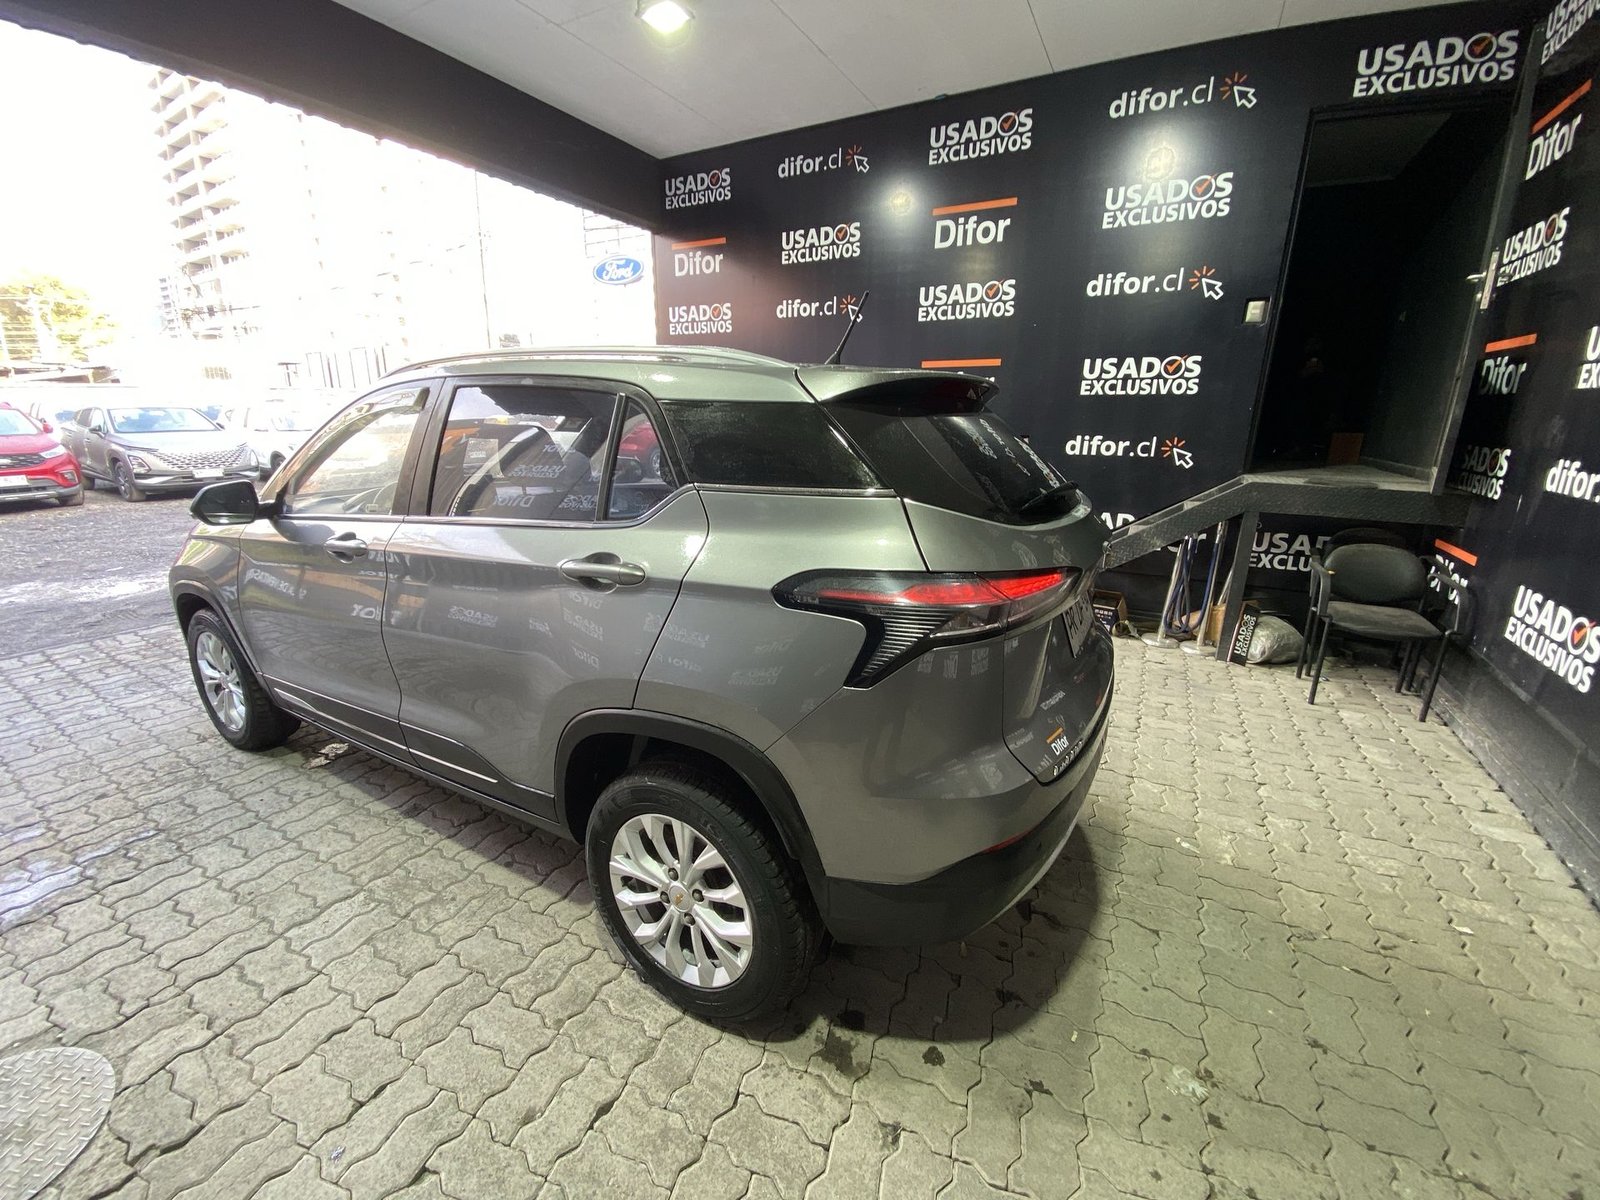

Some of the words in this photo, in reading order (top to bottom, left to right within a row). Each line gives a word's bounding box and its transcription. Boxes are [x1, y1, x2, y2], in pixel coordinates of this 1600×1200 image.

[1546, 0, 1588, 39] USA
[1357, 29, 1519, 75] USADOS
[1352, 59, 1516, 98] EXCLUSIVOS
[1109, 76, 1215, 119] difor.cl
[930, 108, 1033, 147] USADOS
[777, 147, 842, 178] difor.cl
[928, 132, 1032, 165] EXCLUSIVOS
[1525, 113, 1582, 181] Difor
[665, 167, 731, 197] USADOS
[1105, 172, 1234, 211] USADOS
[665, 186, 731, 210] EXCLUSIVOS
[1102, 197, 1230, 230] EXCLUSIVOS
[781, 221, 861, 249] USADOS
[934, 215, 1011, 249] Difor
[1502, 206, 1570, 264] USADOS
[602, 258, 635, 280] Ford
[674, 251, 723, 277] Difor
[781, 242, 861, 265] EXCLUSIVOS
[1496, 241, 1563, 287] EXCLUSIVOS
[918, 279, 1016, 306] USADOS
[1086, 267, 1184, 297] difor.cl
[669, 302, 732, 323] USADOS
[776, 297, 837, 319] difor.cl
[917, 297, 1015, 322] EXCLUSIVOS
[669, 319, 732, 336] EXCLUSIVOS
[1082, 355, 1202, 379] USADOS
[1479, 356, 1527, 395] Difor
[1080, 378, 1199, 396] EXCLUSIVOS
[1065, 435, 1157, 458] difor.cl
[1249, 552, 1312, 572] EXCLU
[1234, 613, 1251, 655] USADOS
[1240, 616, 1257, 657] EXCLUSIVOS
[1513, 584, 1600, 664] USADOS
[1504, 616, 1595, 694] EXCLUSIVOS
[1051, 736, 1070, 756] Difor
